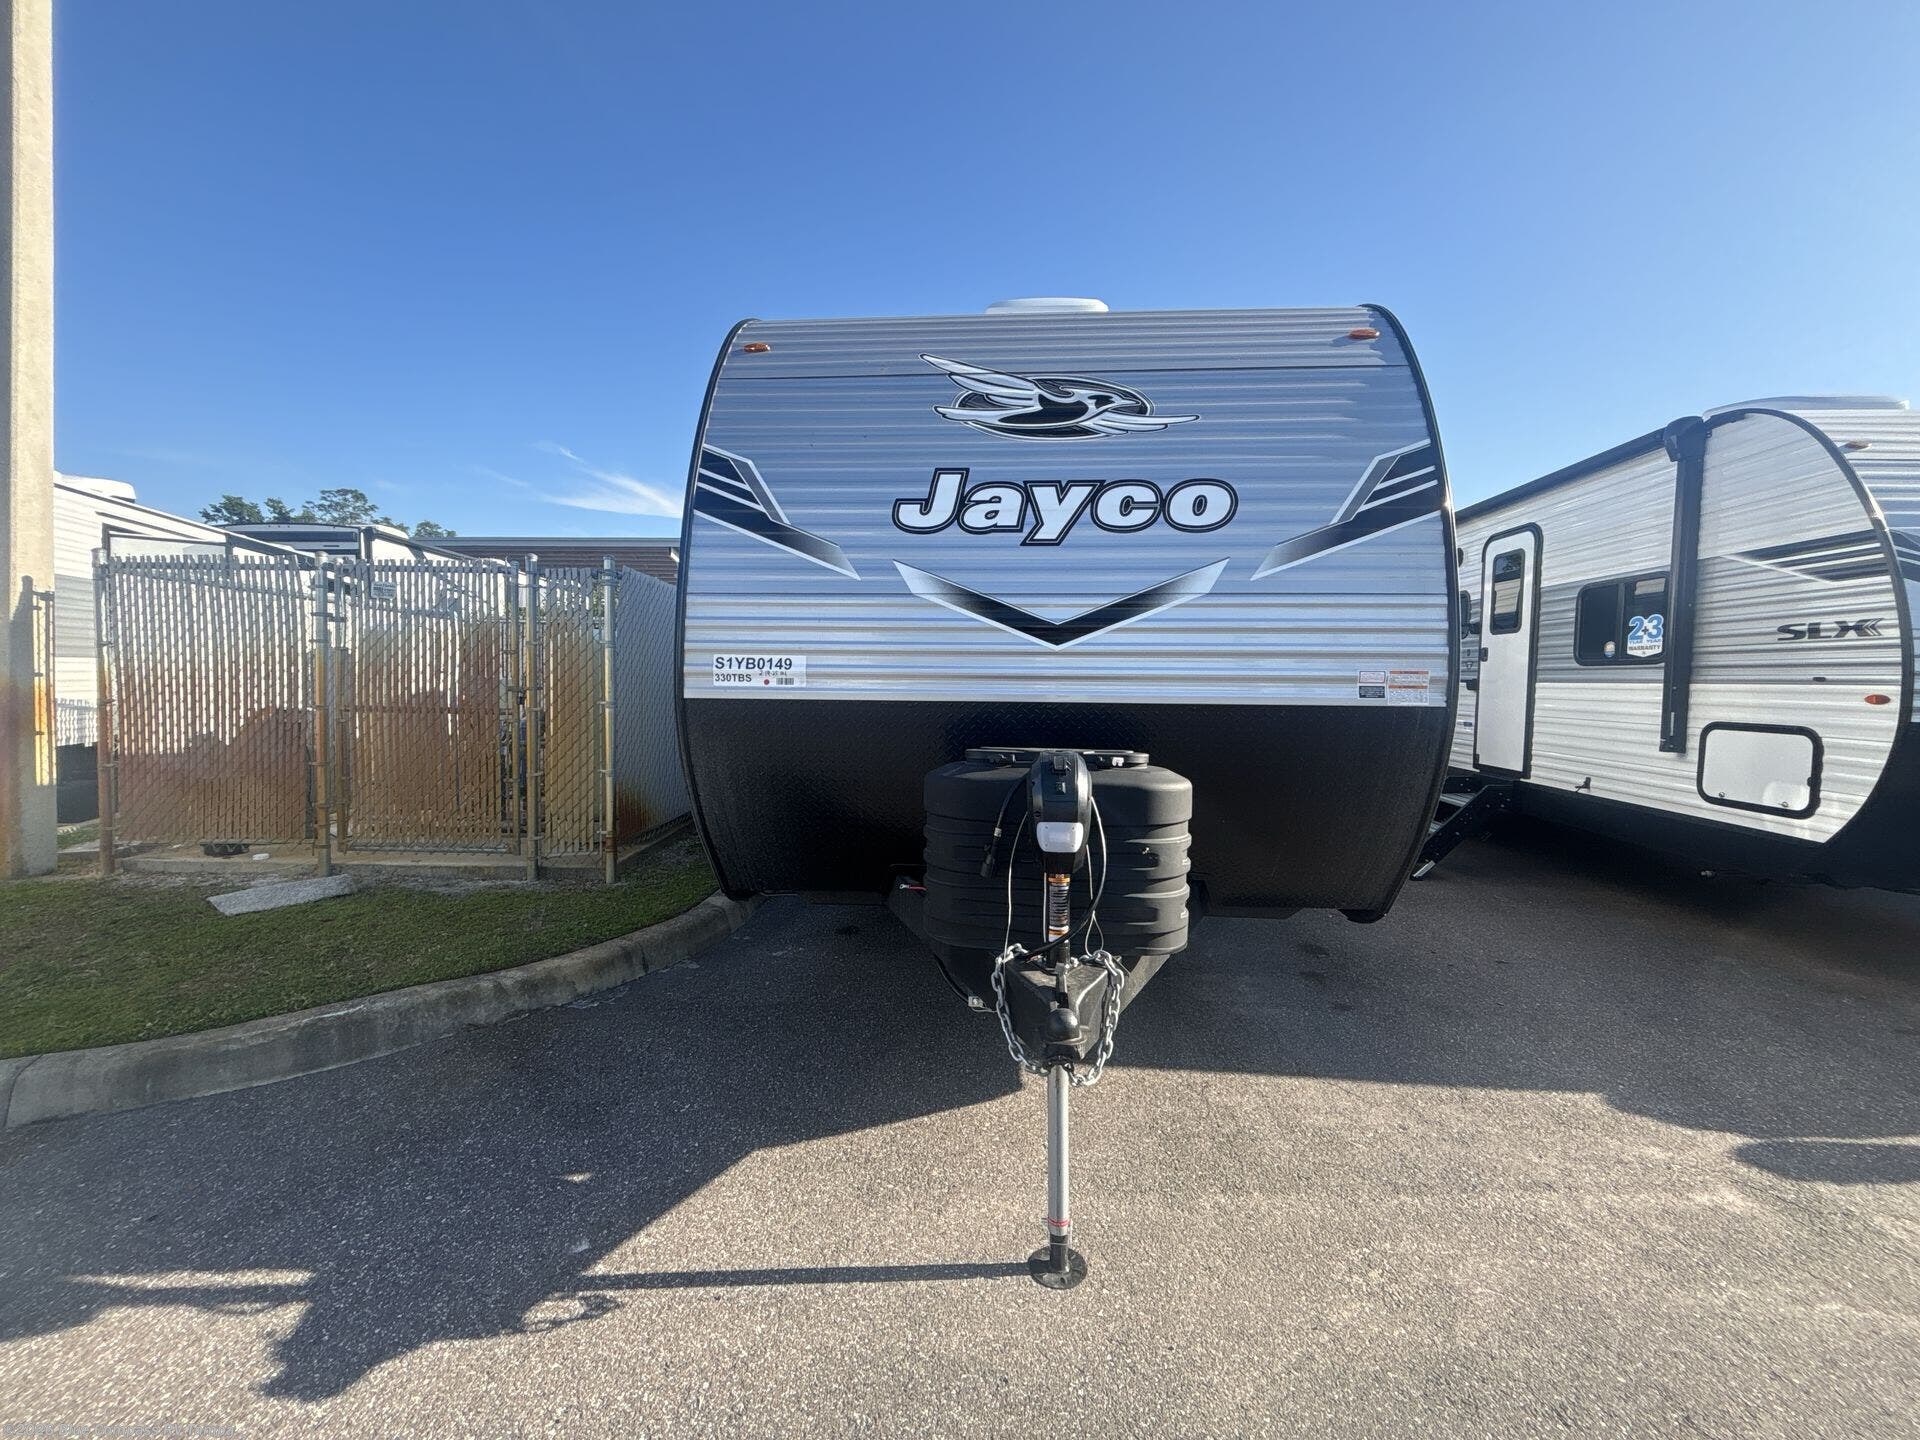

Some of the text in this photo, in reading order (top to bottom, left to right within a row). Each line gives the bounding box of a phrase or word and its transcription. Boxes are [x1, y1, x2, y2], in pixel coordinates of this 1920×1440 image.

[892, 468, 1239, 546] Jayco
[1776, 618, 1884, 641] SLX
[715, 656, 793, 670] S1YB0149
[714, 673, 752, 683] 330TBS
